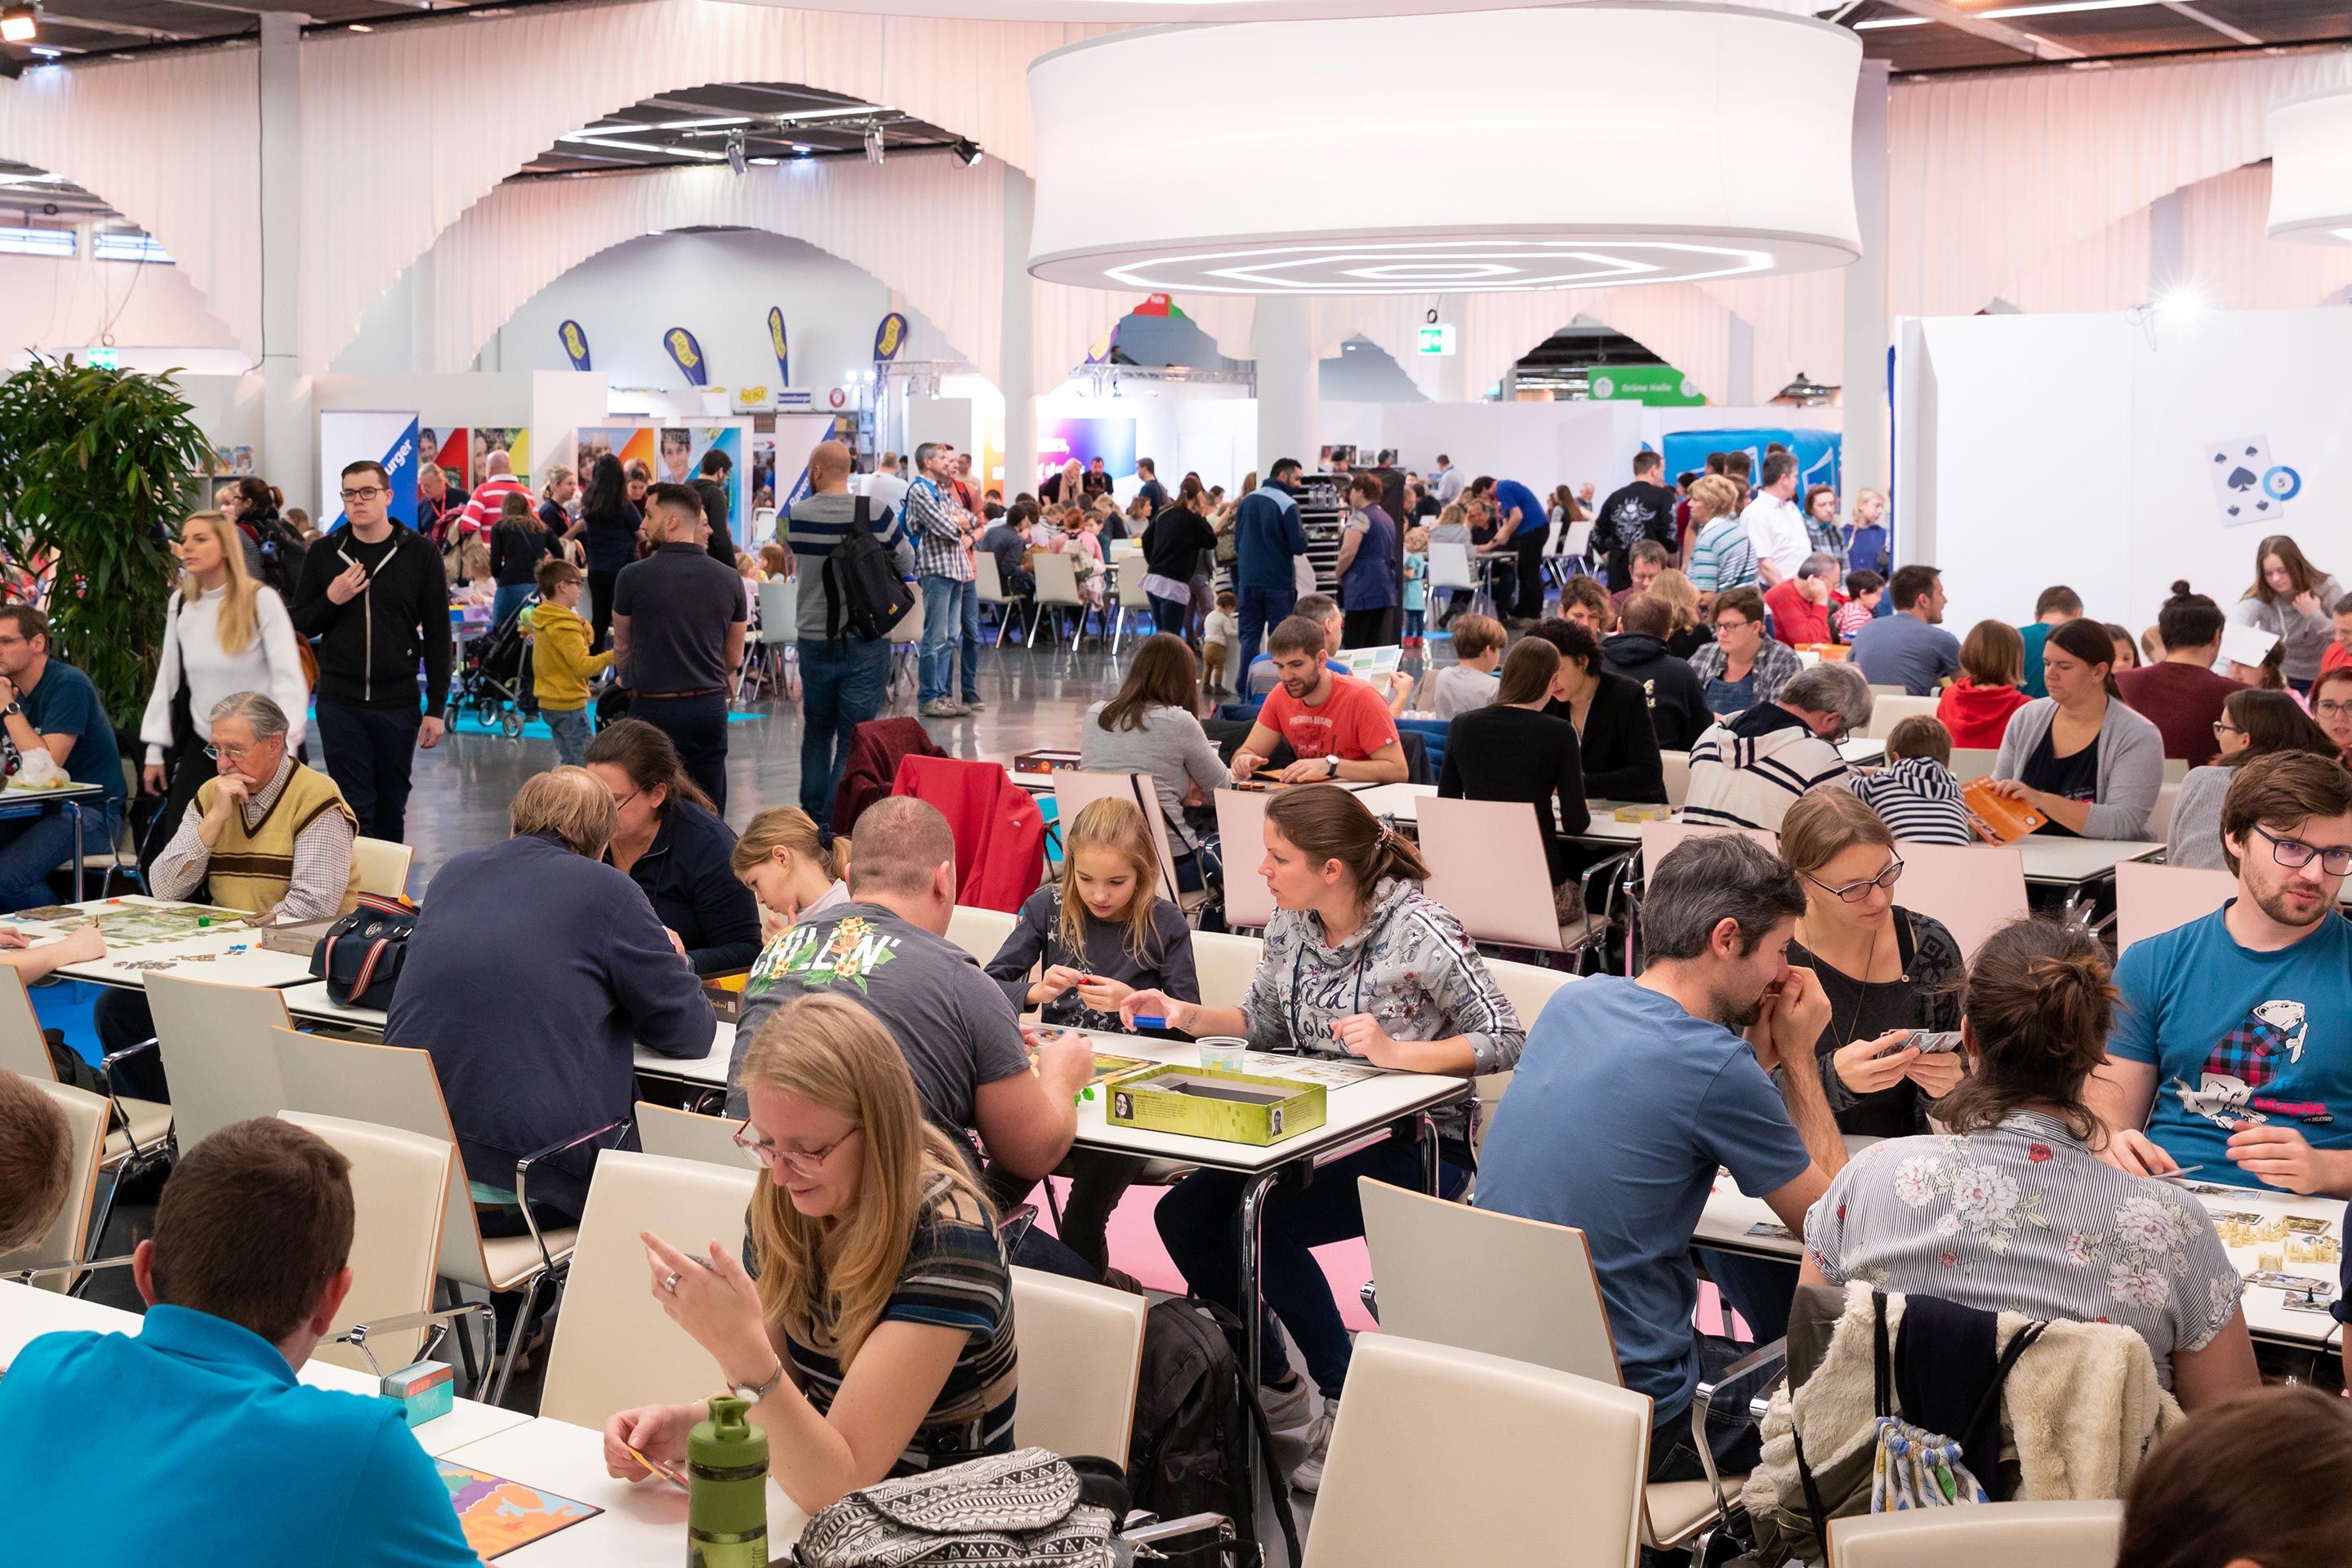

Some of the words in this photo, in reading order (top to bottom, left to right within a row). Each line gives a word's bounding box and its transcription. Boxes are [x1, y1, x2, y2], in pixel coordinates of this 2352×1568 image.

[1650, 383, 1672, 392] Halle
[384, 439, 412, 476] urger
[789, 477, 810, 506] Raven
[2278, 477, 2286, 488] 5
[1293, 977, 1348, 1009] ild
[2255, 1097, 2326, 1117] Maple
